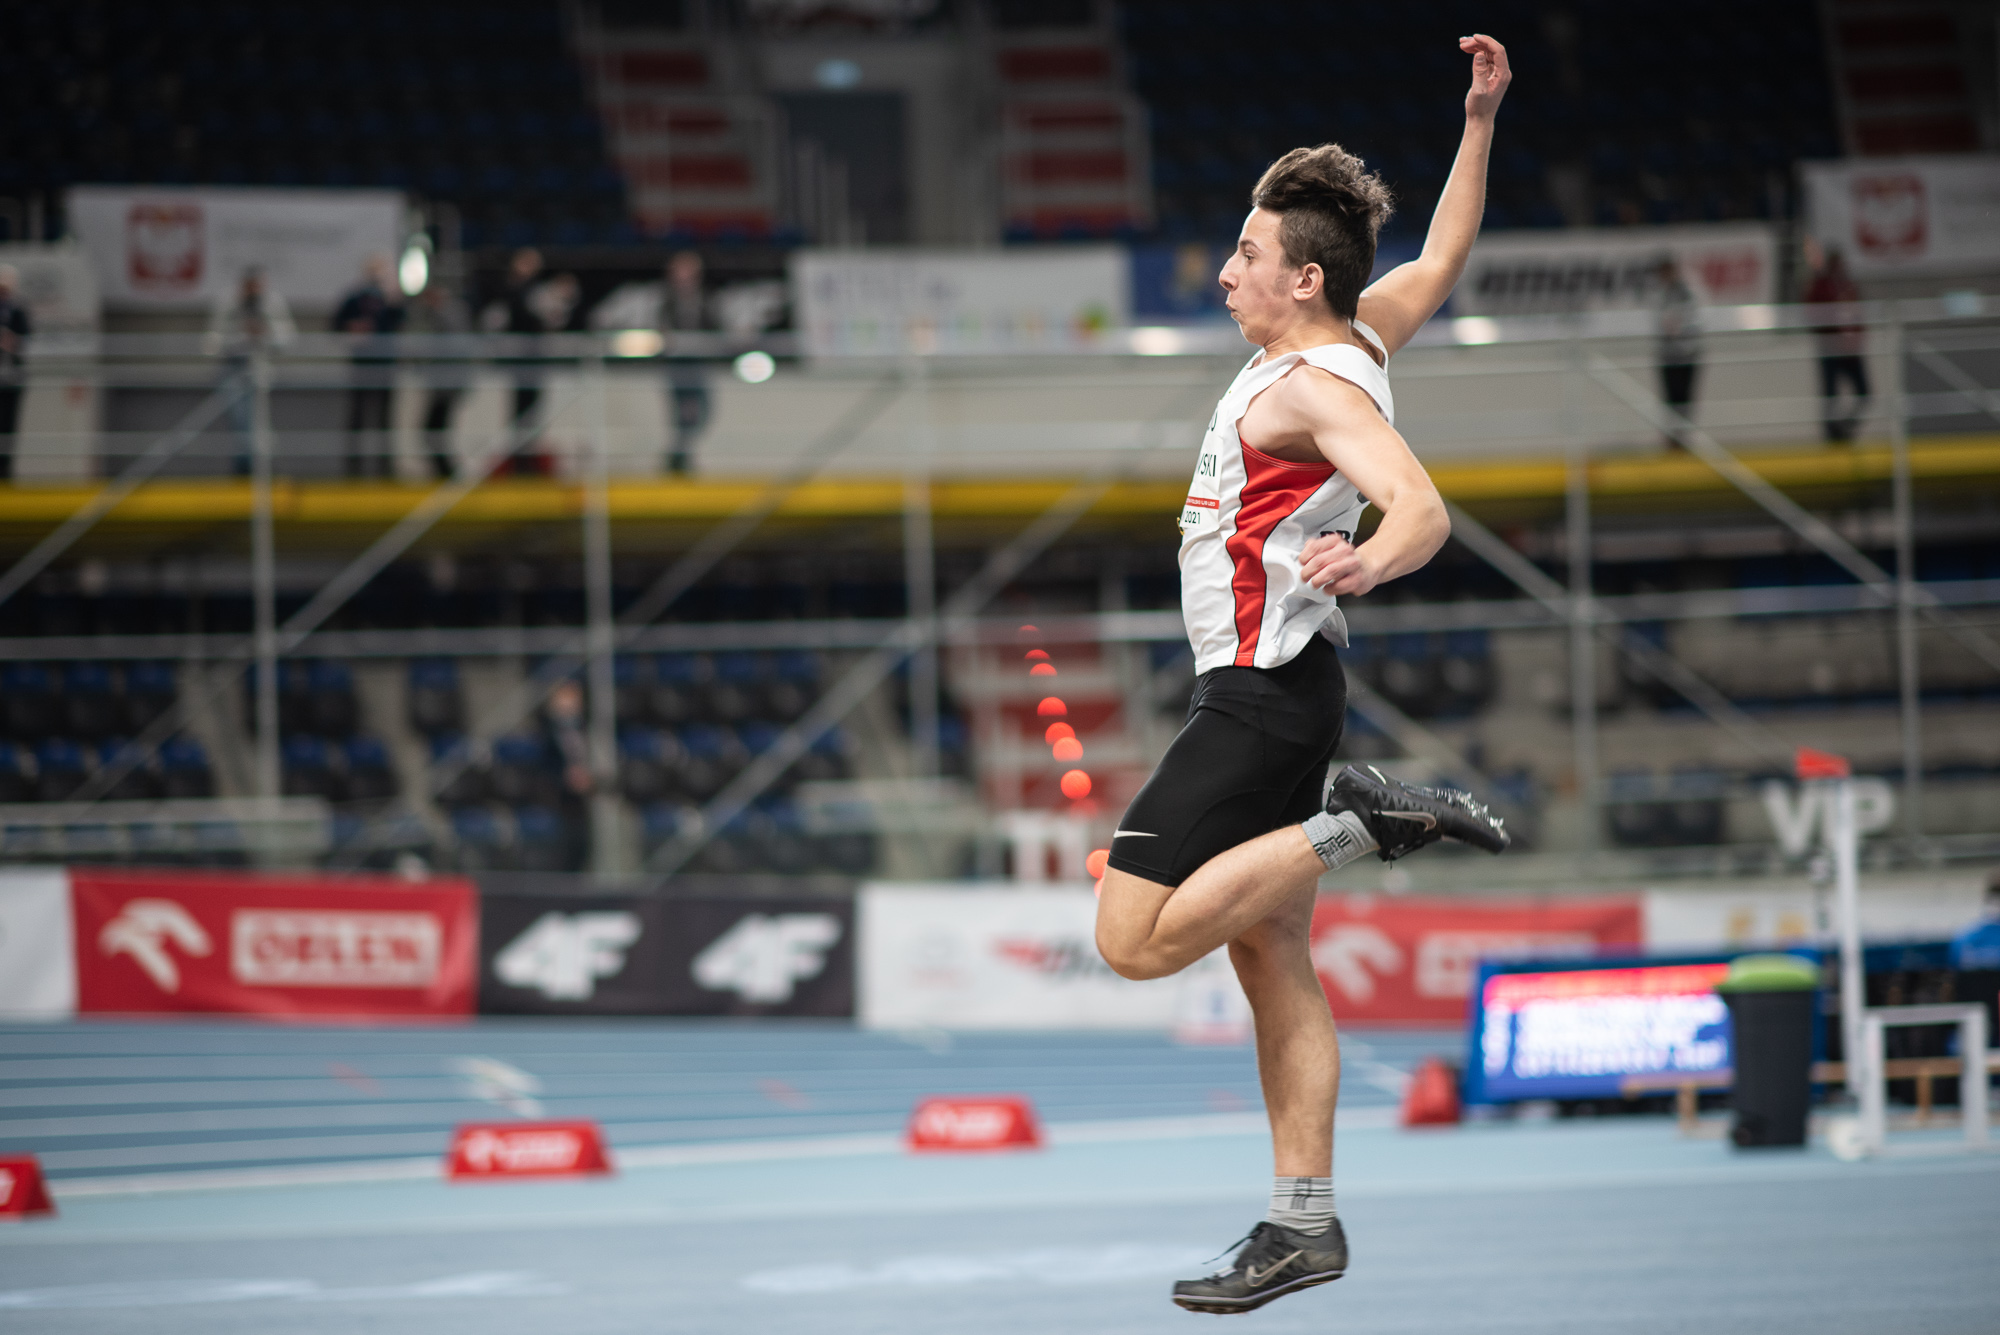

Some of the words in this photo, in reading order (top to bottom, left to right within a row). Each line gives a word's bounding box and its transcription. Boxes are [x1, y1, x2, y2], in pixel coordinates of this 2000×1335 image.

[1184, 510, 1201, 525] 2021
[494, 910, 642, 1000] 4F
[691, 912, 841, 1003] 4F
